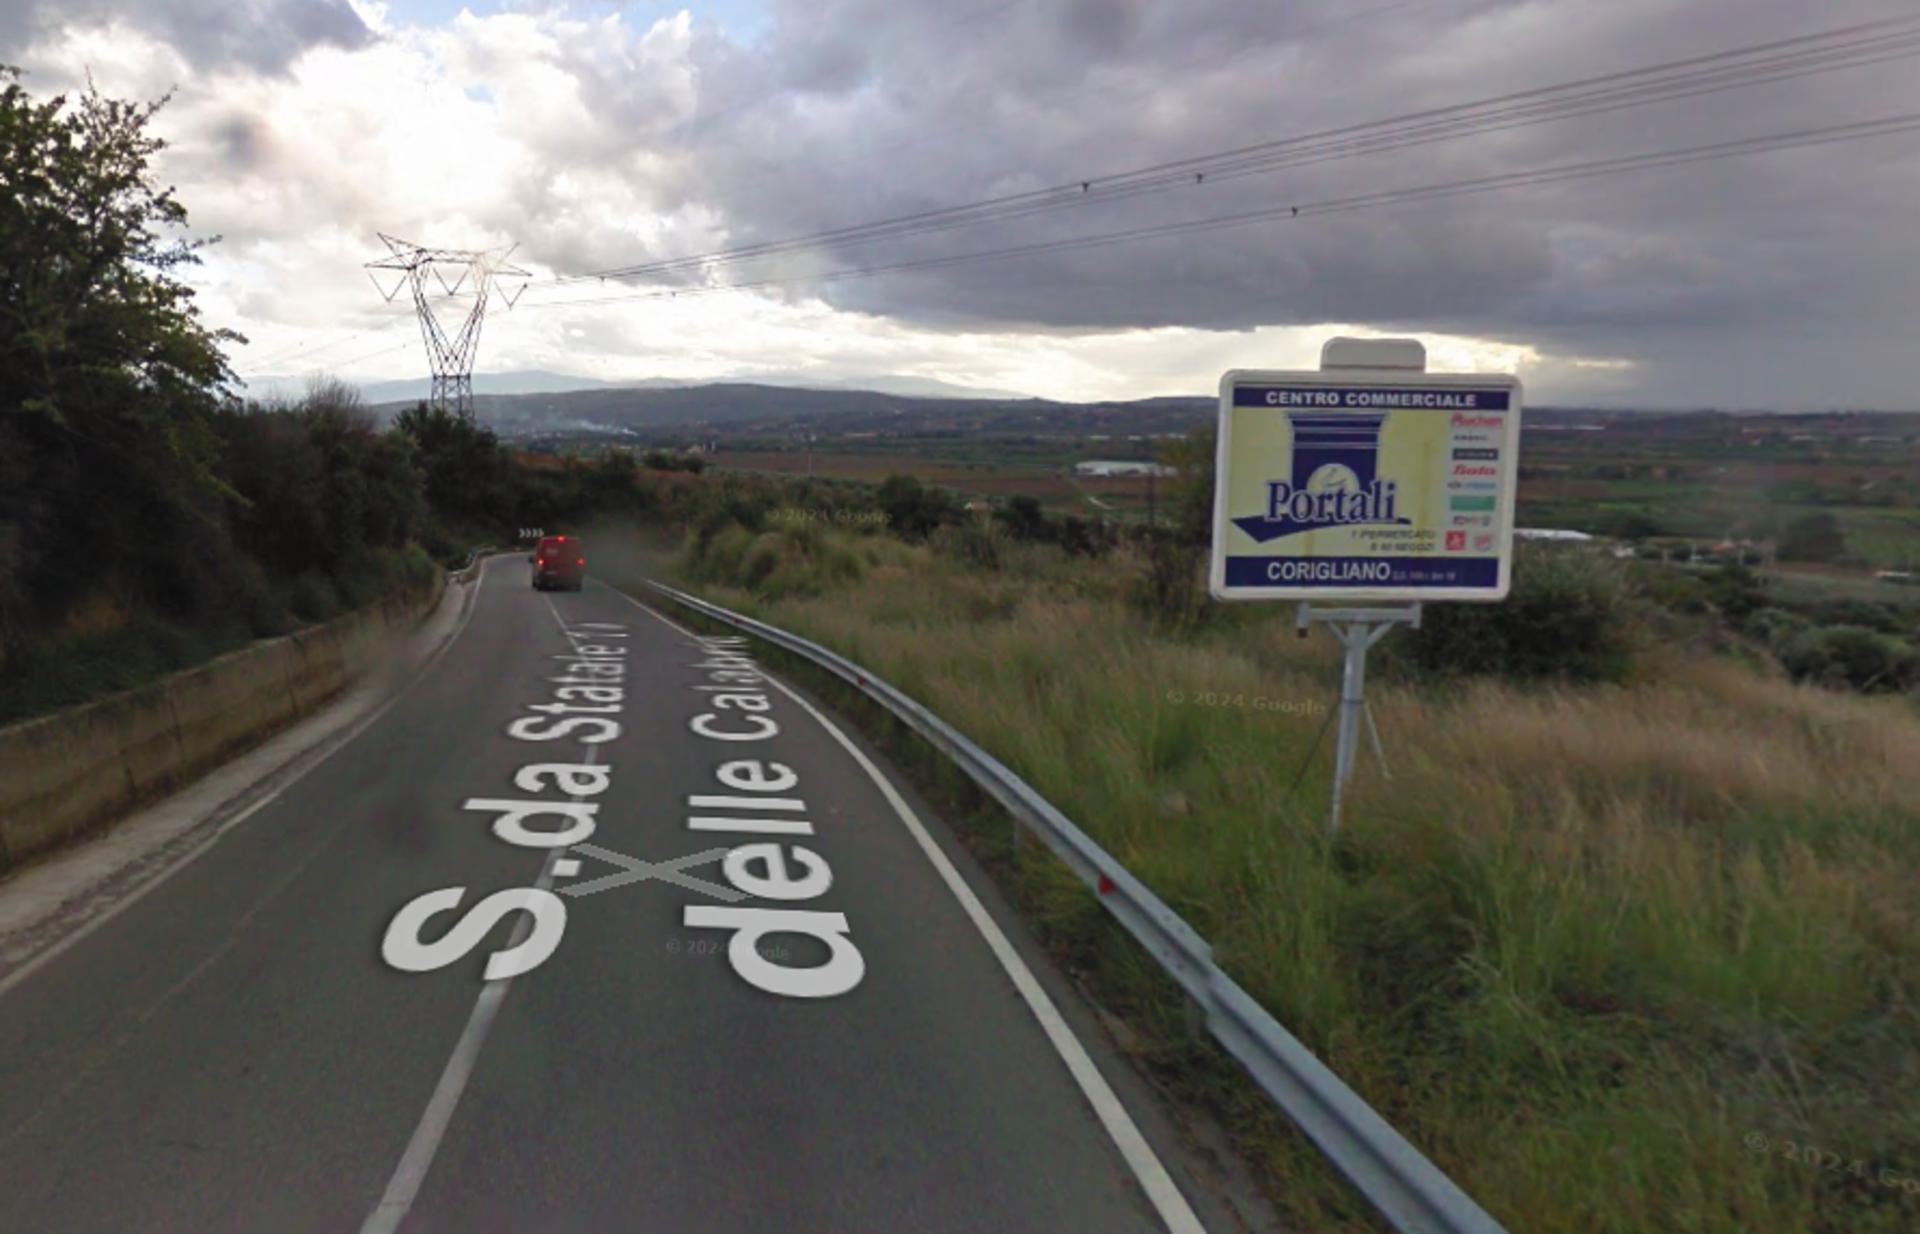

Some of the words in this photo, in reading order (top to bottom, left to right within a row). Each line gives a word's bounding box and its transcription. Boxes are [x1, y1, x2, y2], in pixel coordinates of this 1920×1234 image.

[1266, 391, 1340, 405] CENTRO
[1345, 392, 1477, 408] COMMERCIALE
[1265, 480, 1396, 523] Portali
[1267, 561, 1391, 581] CORIGLIANO
